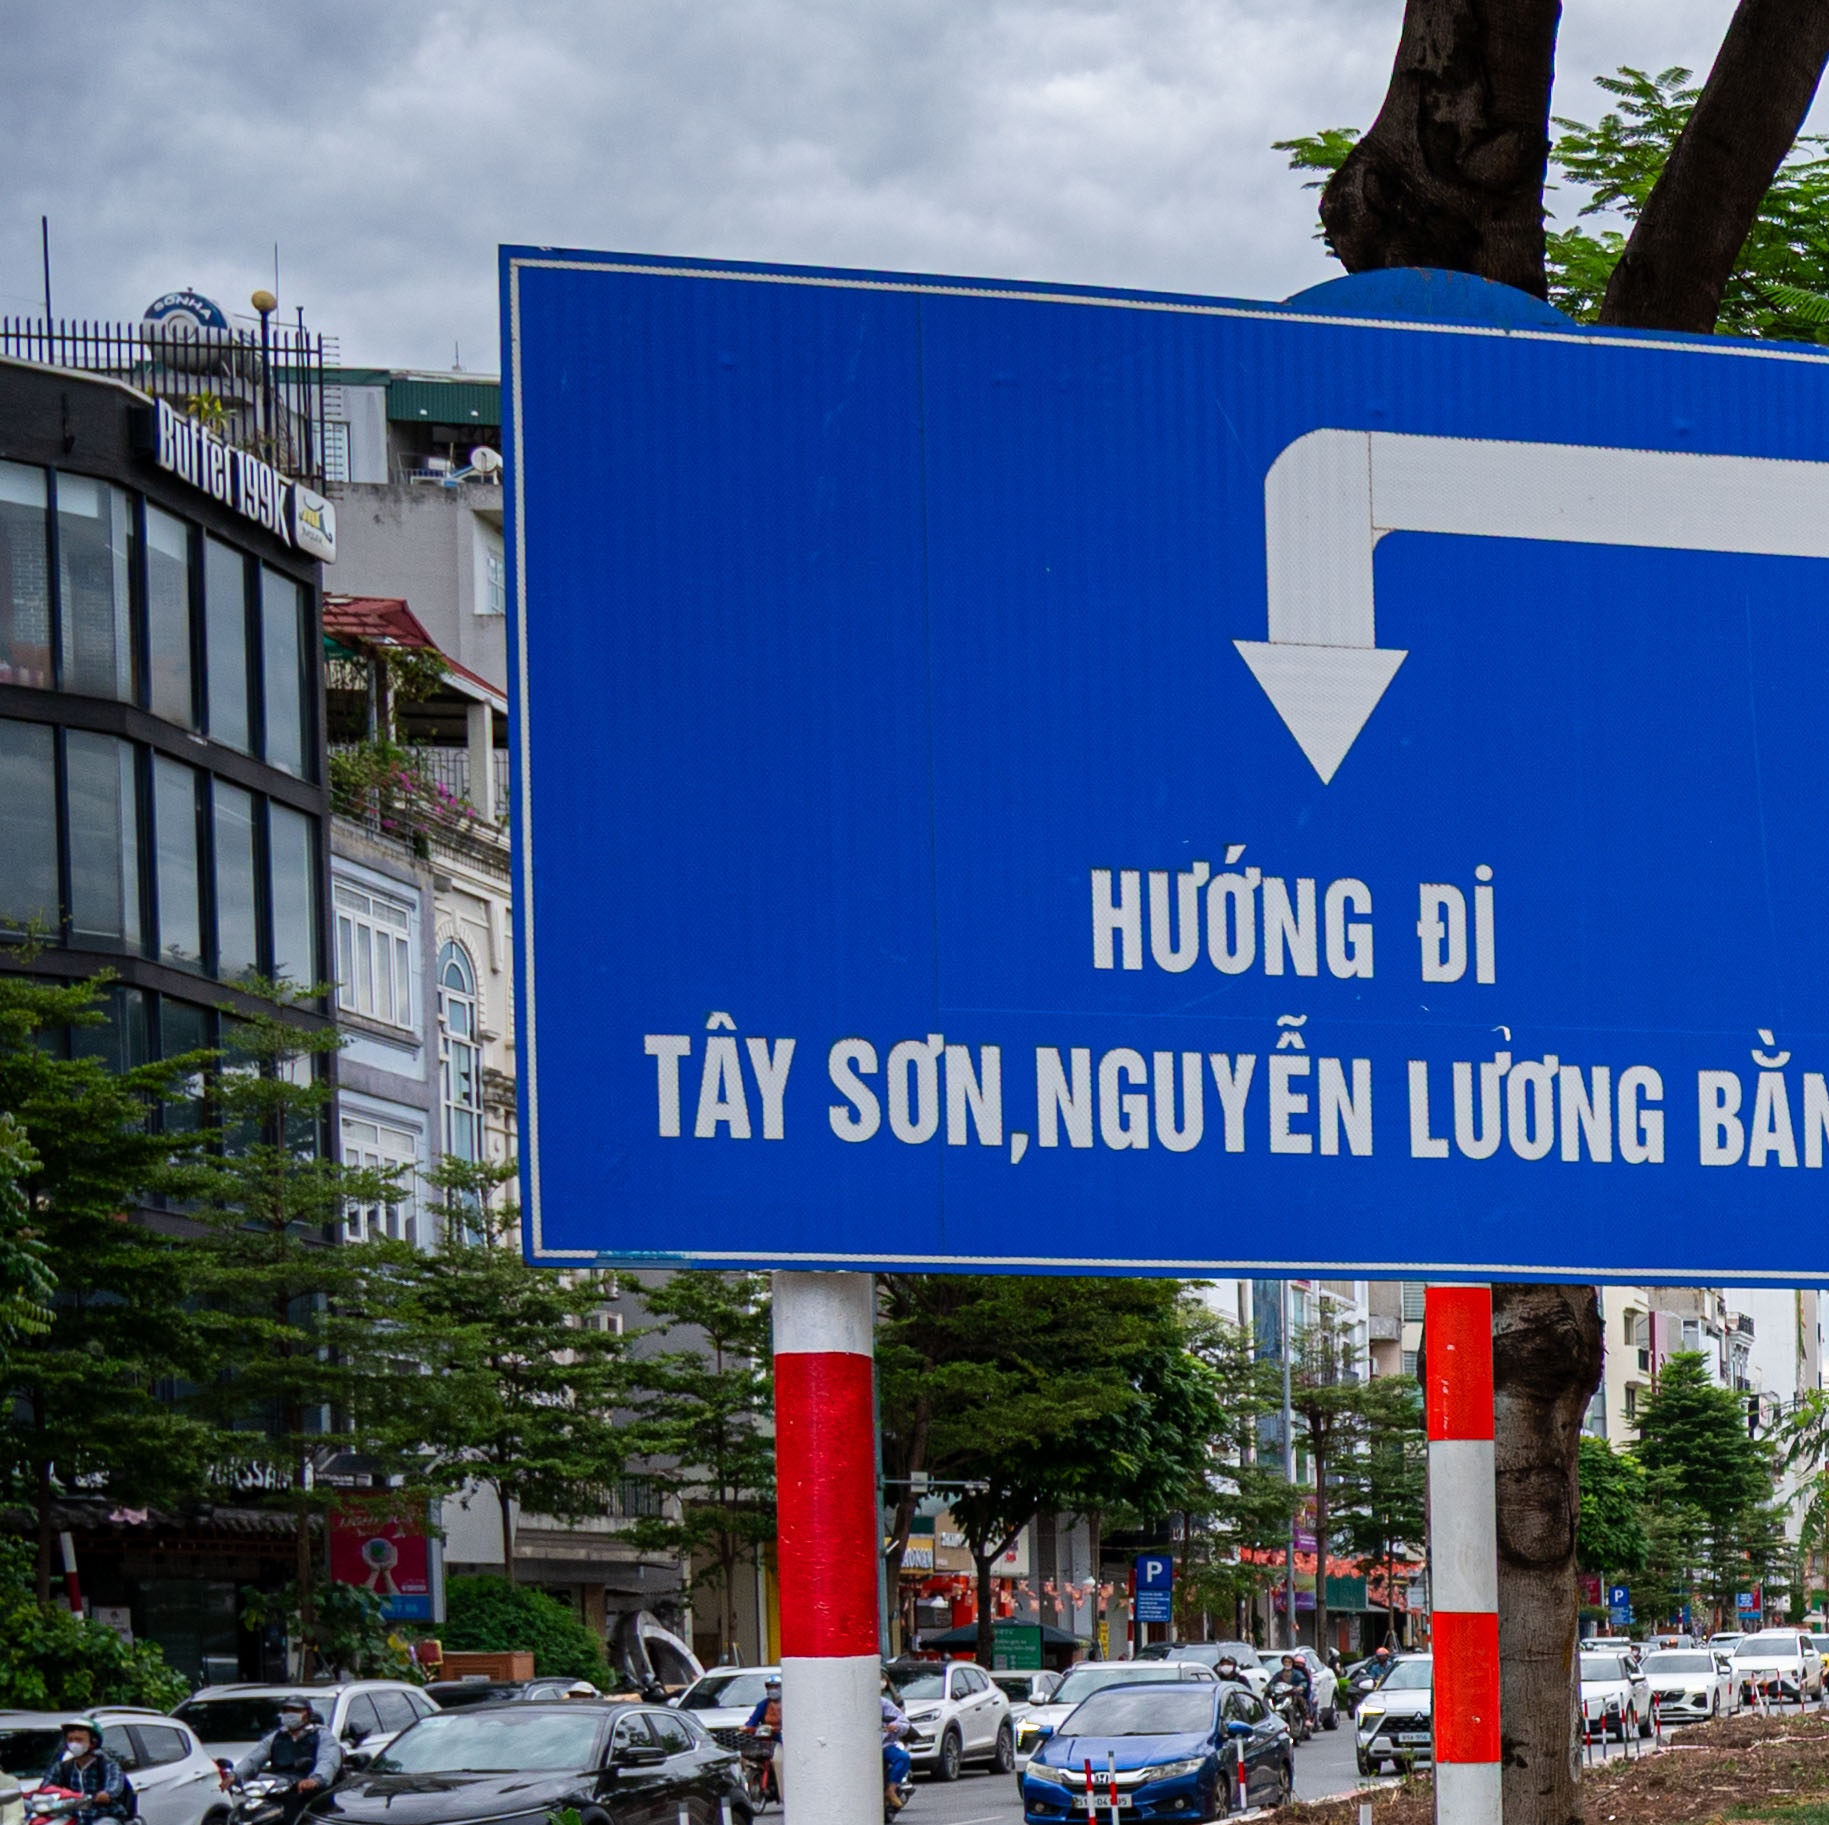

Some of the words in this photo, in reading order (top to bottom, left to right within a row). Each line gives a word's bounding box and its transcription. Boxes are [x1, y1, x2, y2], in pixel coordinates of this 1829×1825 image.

[158, 397, 233, 507] Buffet
[235, 448, 293, 549] 199K
[1091, 844, 1374, 980] HƯỚNG
[643, 1011, 797, 1141] TÂY
[1146, 1560, 1164, 1583] P
[1614, 1589, 1624, 1602] P
